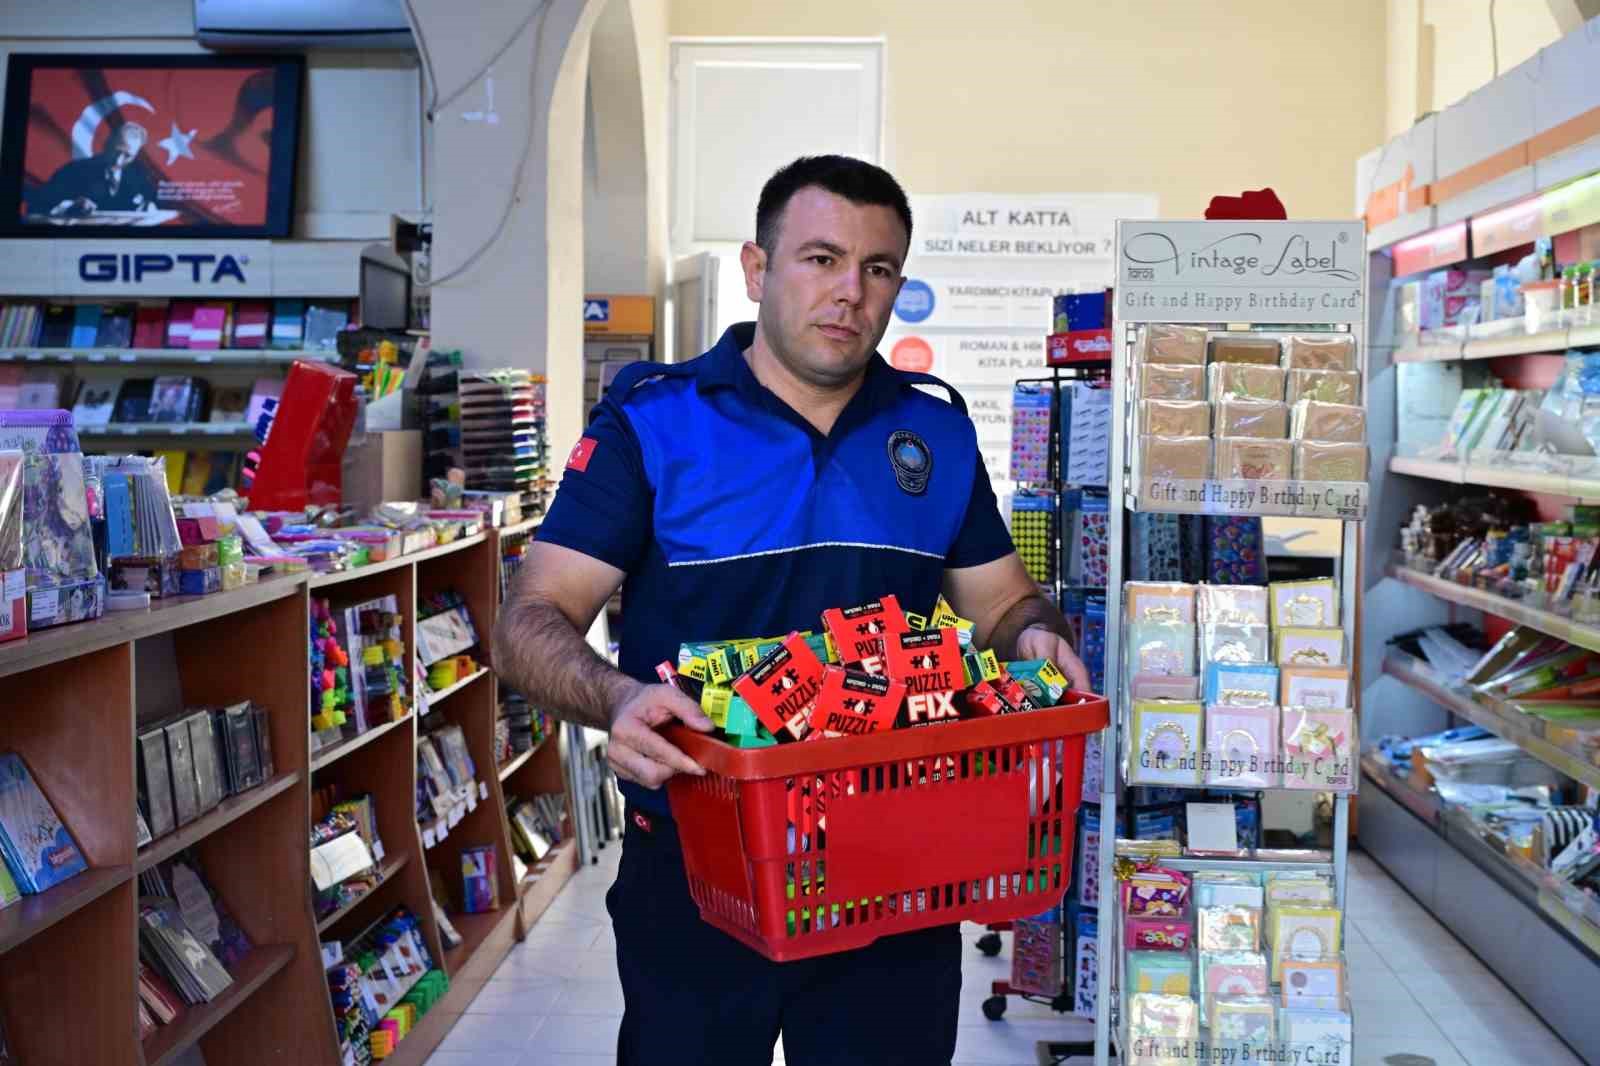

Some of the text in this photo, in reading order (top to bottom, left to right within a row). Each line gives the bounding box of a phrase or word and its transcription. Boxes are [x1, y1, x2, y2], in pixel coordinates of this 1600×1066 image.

[962, 210, 1071, 226] ALT KATTA
[957, 240, 1010, 253] NELER
[1014, 240, 1096, 255] BEKLİYOR
[1123, 232, 1263, 275] Vintage
[79, 254, 246, 283] GIPTA
[1125, 291, 1155, 307] Gift
[1161, 291, 1189, 307] and
[1195, 291, 1243, 312] Happy
[1248, 291, 1315, 312] Birthday
[959, 340, 1008, 352] ROMAN
[1211, 483, 1255, 509] Happy
[1260, 486, 1321, 511] Birthday
[905, 671, 952, 694] PUZZLE
[774, 675, 819, 722] PUZZLE
[907, 690, 959, 722] FIX
[826, 711, 880, 735] PUZZLE
